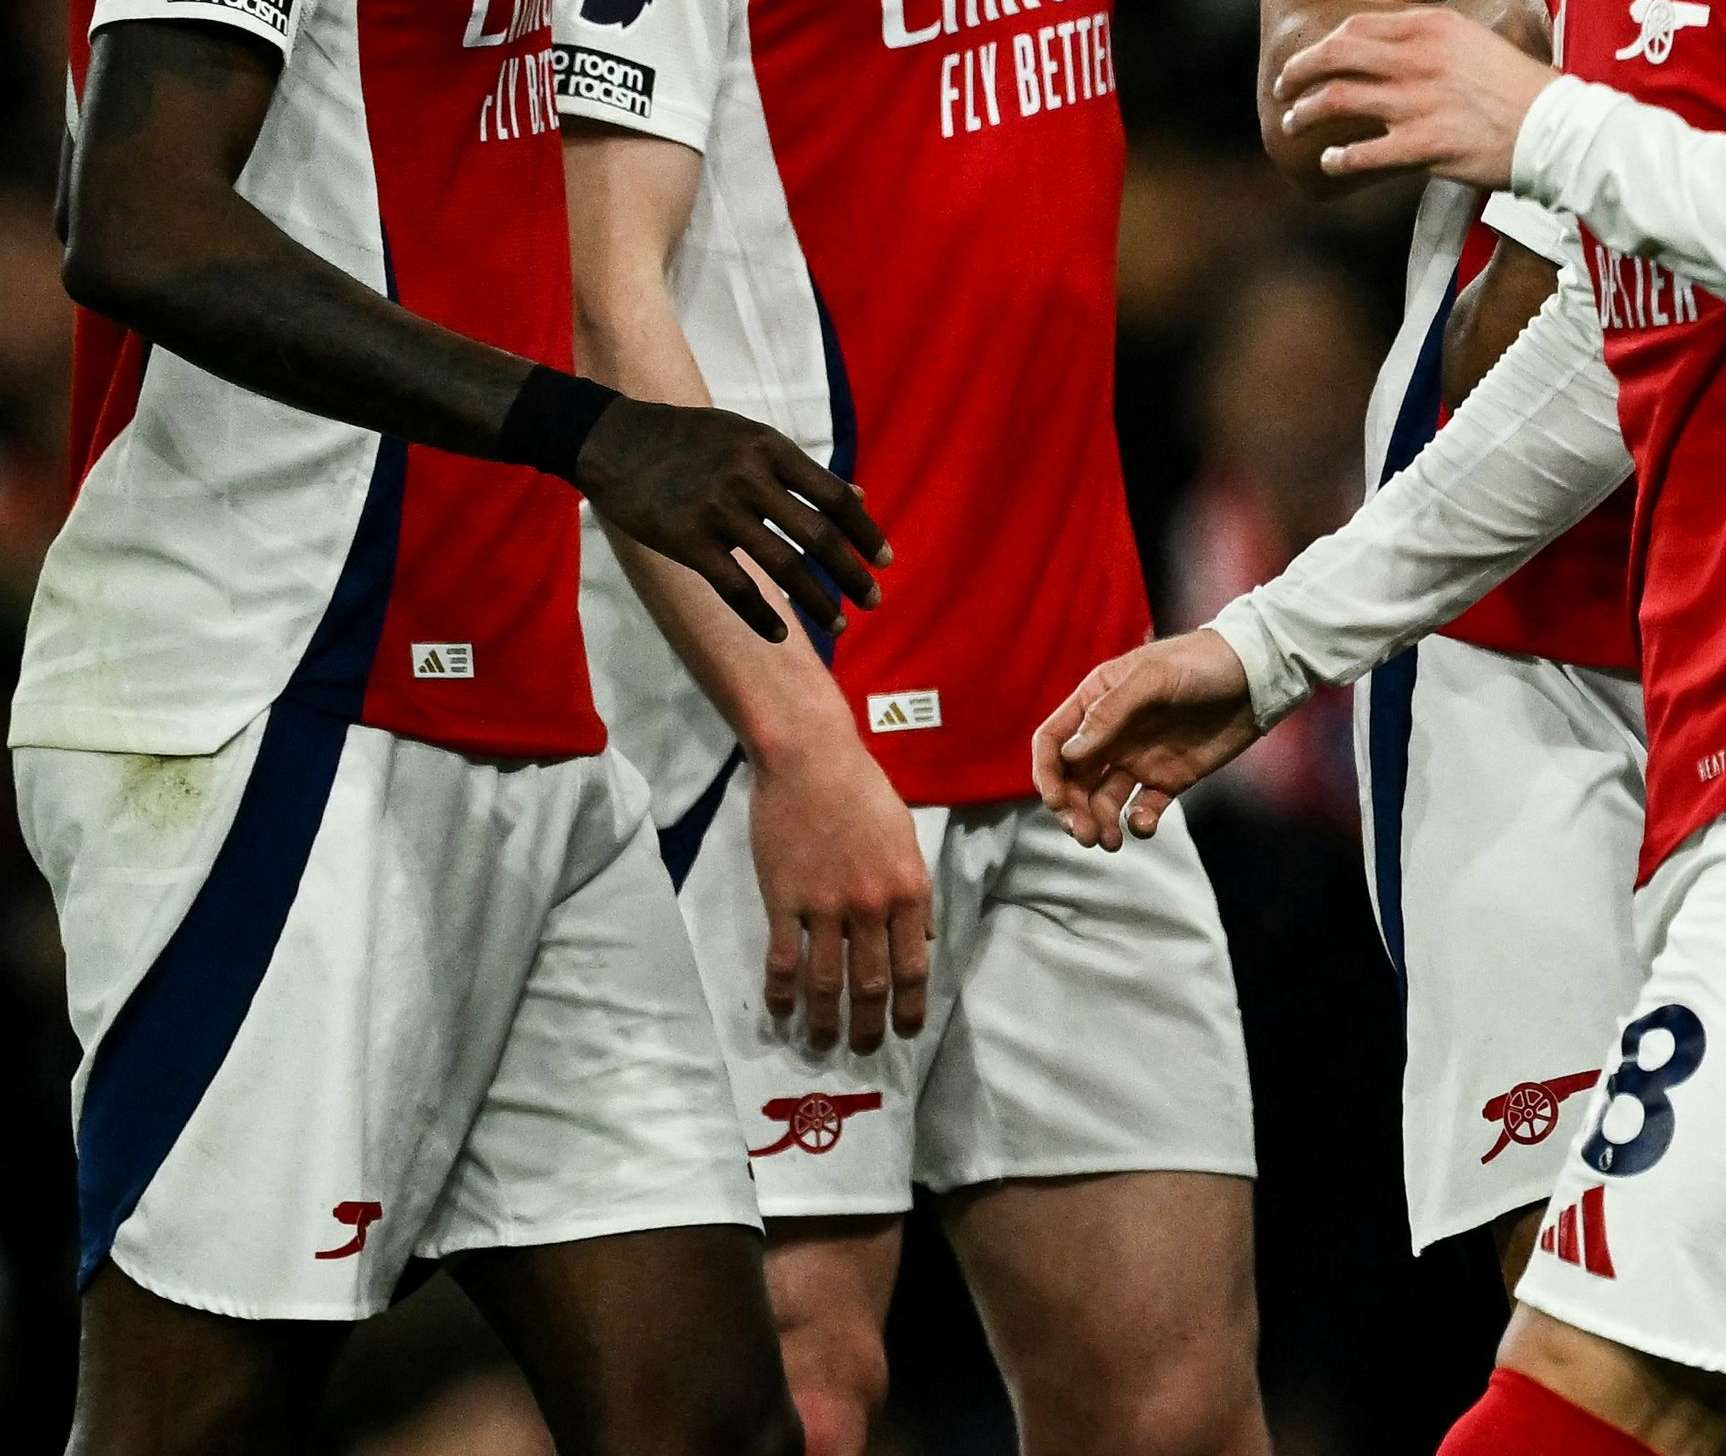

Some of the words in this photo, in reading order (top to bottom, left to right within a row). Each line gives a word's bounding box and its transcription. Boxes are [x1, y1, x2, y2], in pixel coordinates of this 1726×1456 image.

[568, 75, 651, 118] racism
[573, 52, 644, 91] room
[940, 41, 1001, 138] FLY
[1581, 1003, 1707, 1178] 8
